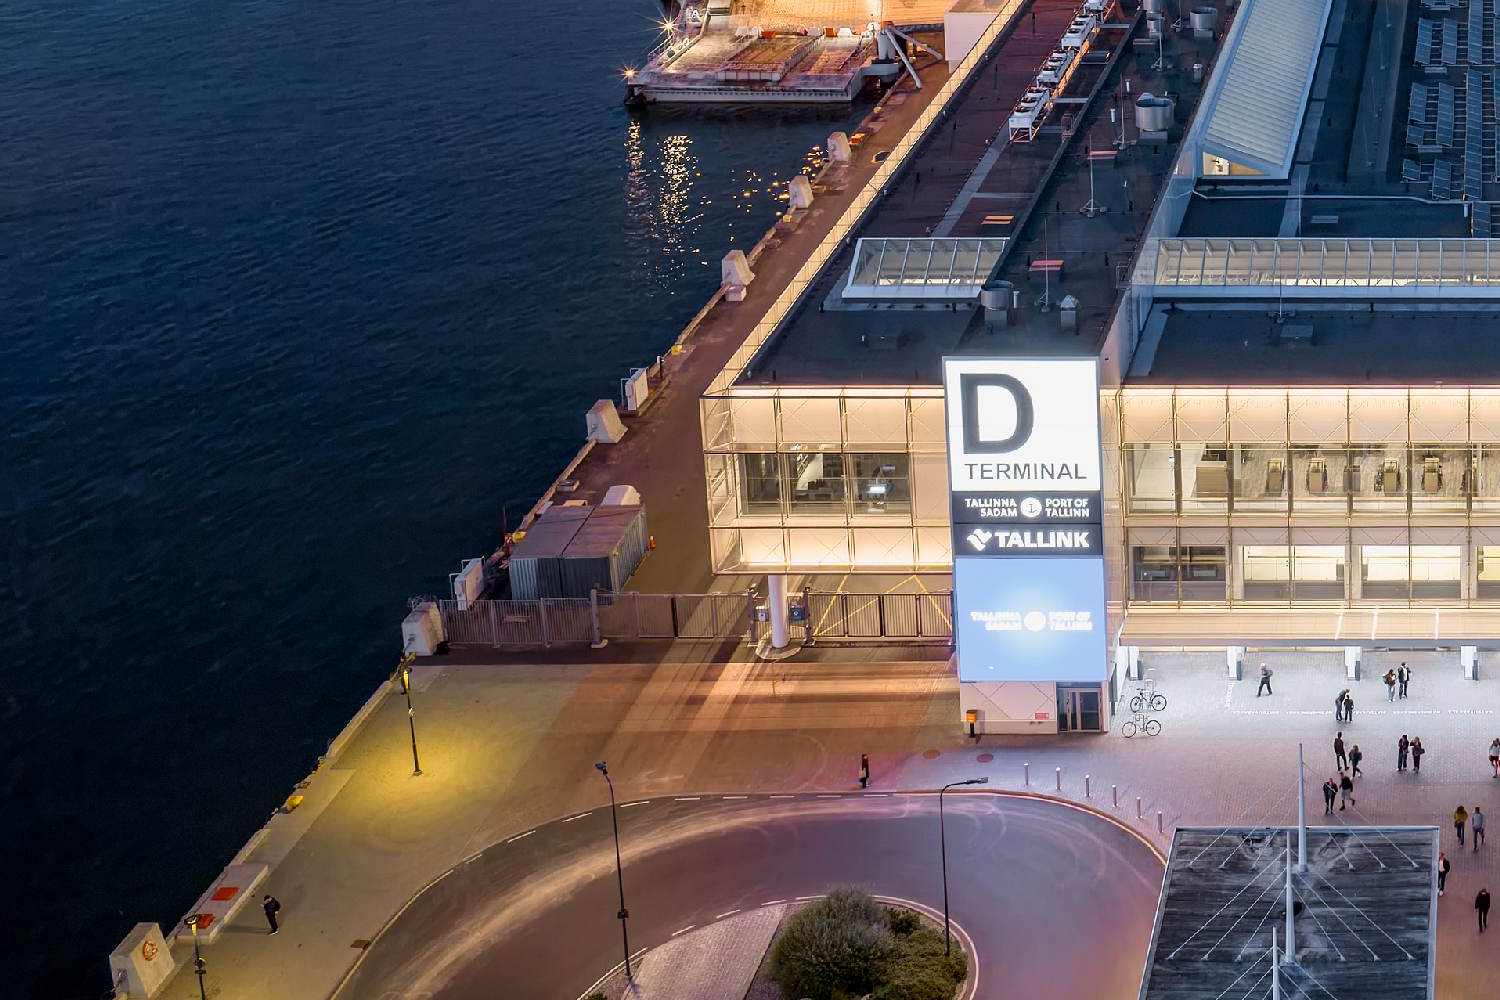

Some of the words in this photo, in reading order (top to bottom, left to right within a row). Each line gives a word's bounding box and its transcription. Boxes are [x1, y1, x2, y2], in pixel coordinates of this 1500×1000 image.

[960, 373, 1034, 454] D
[964, 463, 1087, 480] TERMINAL
[964, 498, 1017, 508] TALLINNA
[1045, 498, 1073, 508] PORT
[1074, 498, 1089, 508] OF
[980, 508, 1018, 517] SADAM
[1045, 508, 1090, 517] TALLINN
[994, 531, 1090, 548] TALLINK
